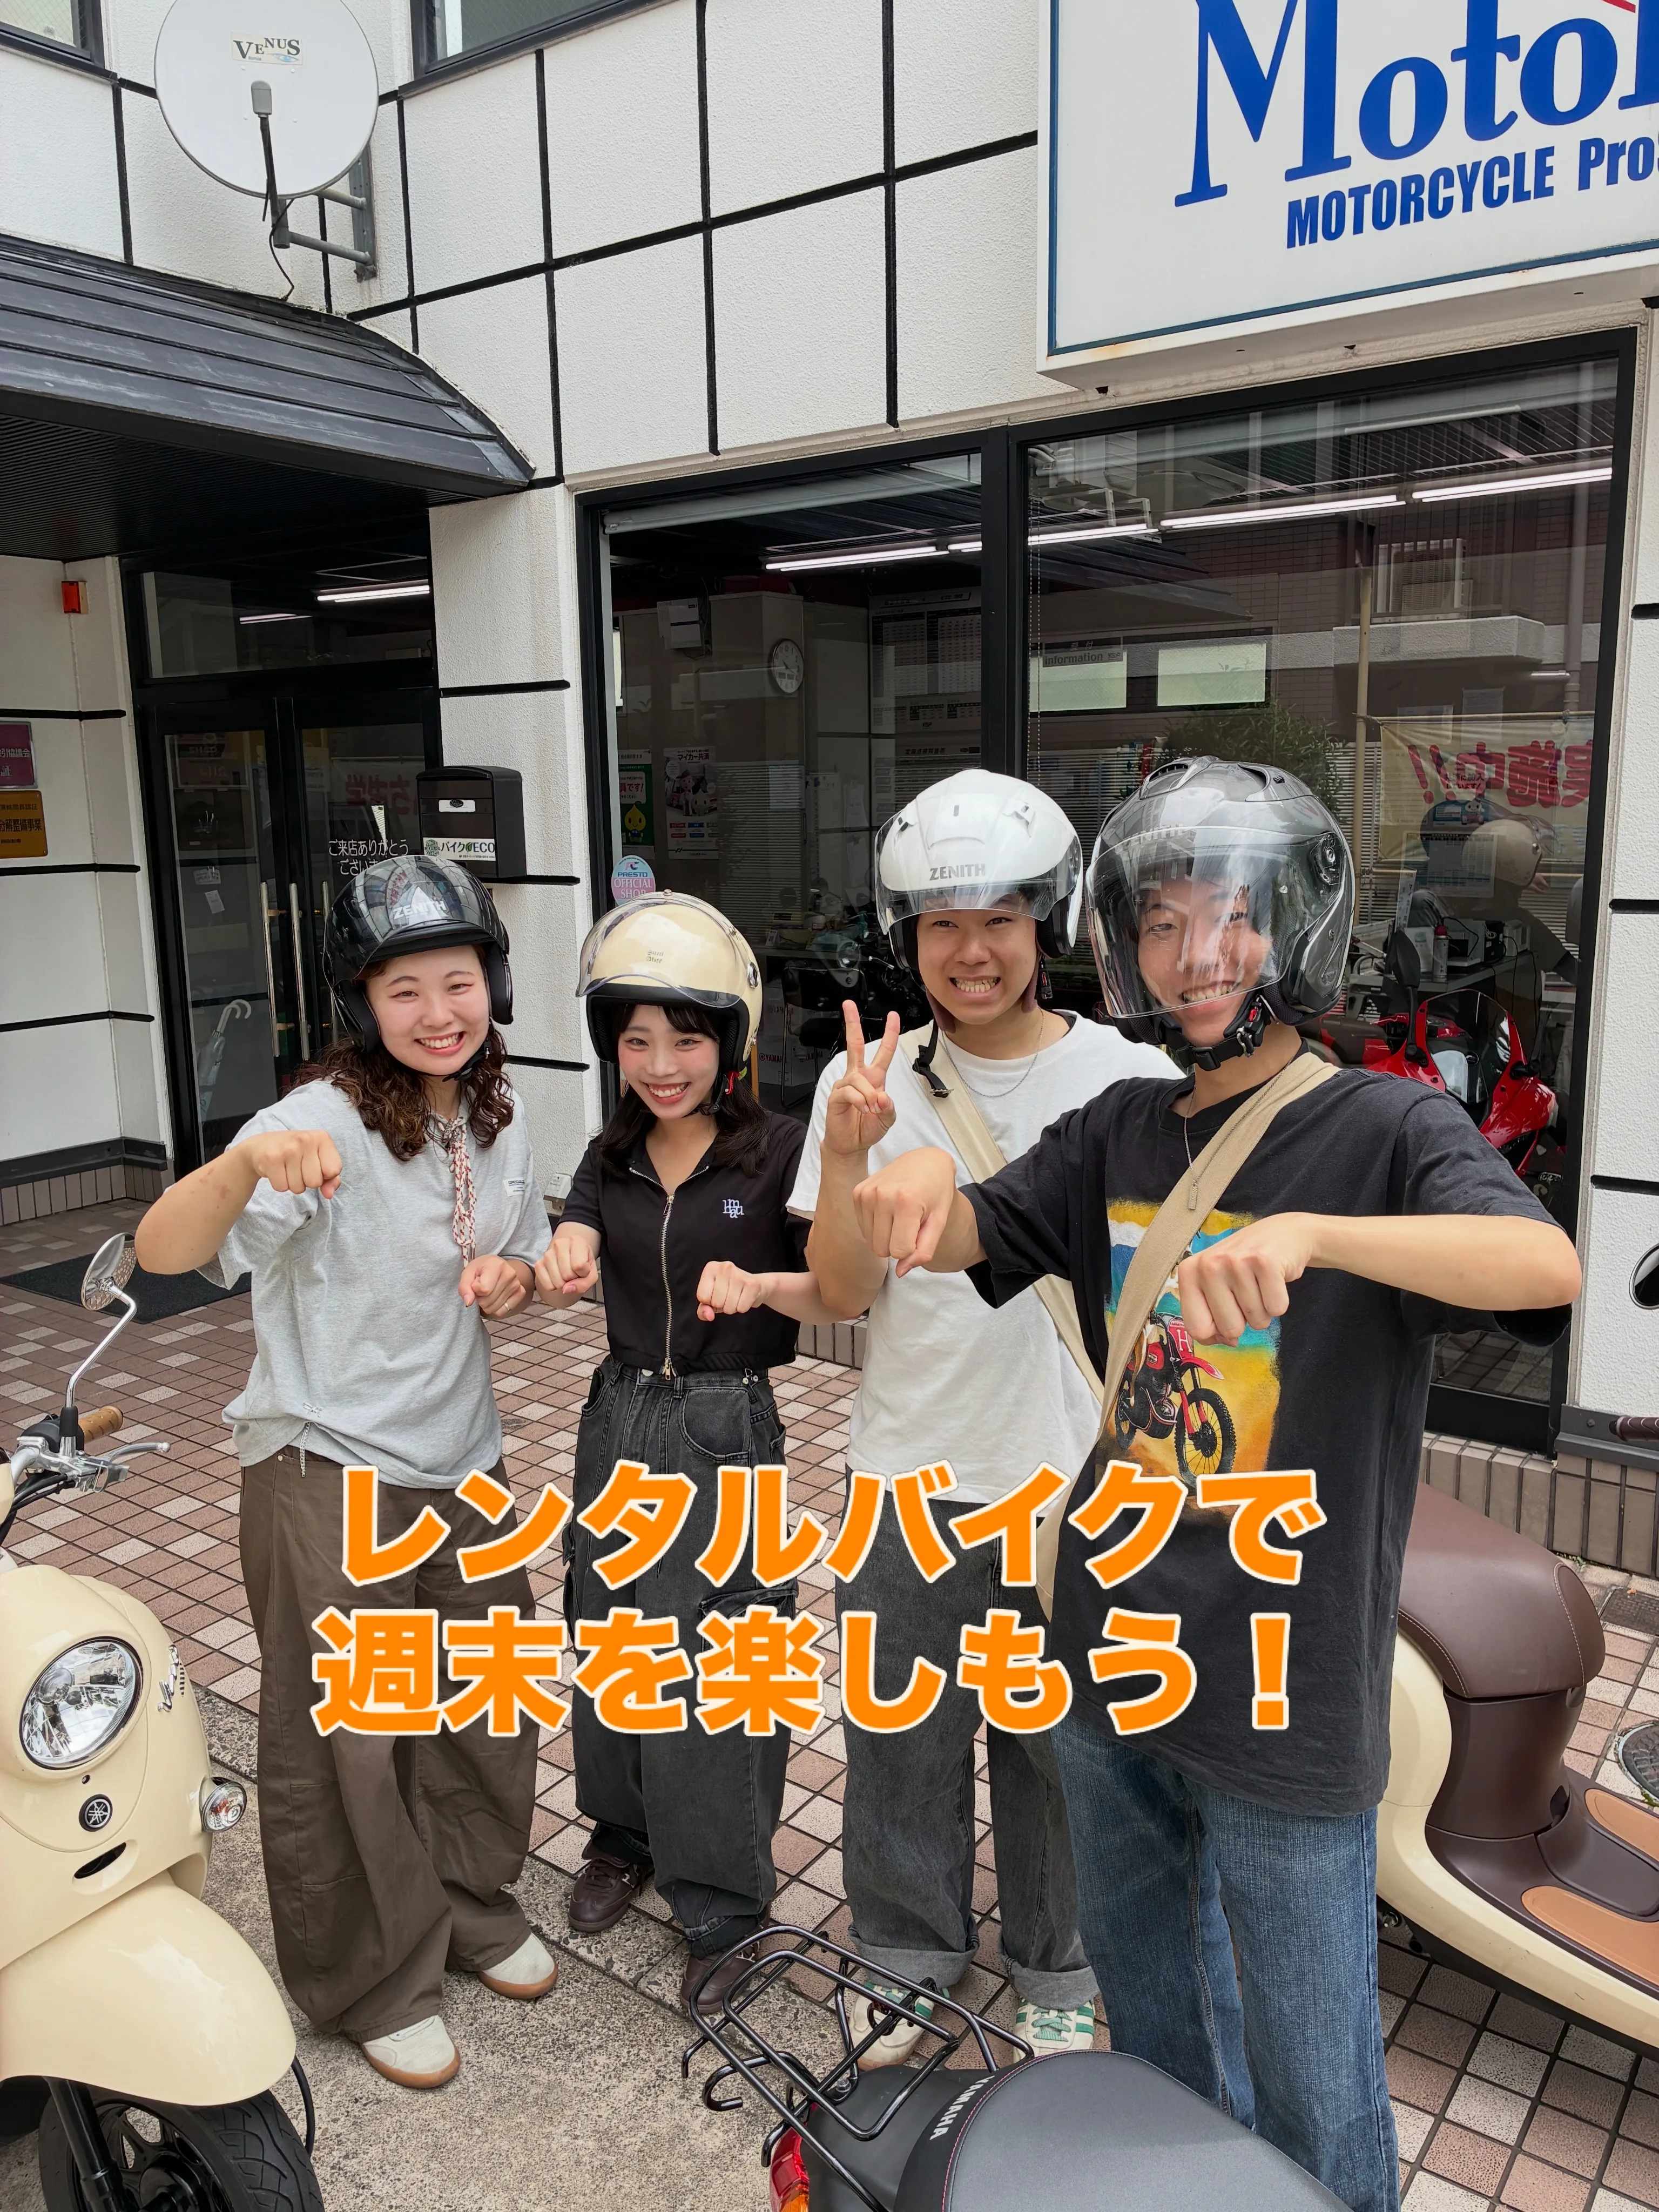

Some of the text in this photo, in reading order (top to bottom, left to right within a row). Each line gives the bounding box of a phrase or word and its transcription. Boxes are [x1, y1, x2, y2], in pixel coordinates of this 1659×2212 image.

[1286, 137, 1659, 249] MOTORCYCLE Pro
[1045, 652, 1103, 665] information
[677, 752, 710, 761] マイカー共済
[328, 839, 409, 857] ご来店ありがとう
[441, 841, 465, 853] バイク
[473, 842, 495, 853] ECO
[929, 864, 986, 881] ZENITH
[613, 878, 653, 888] OFFICIAL
[393, 900, 447, 920] ZENITH
[773, 1005, 794, 1015] YAMHA
[929, 2075, 995, 2141] YAMAHA
